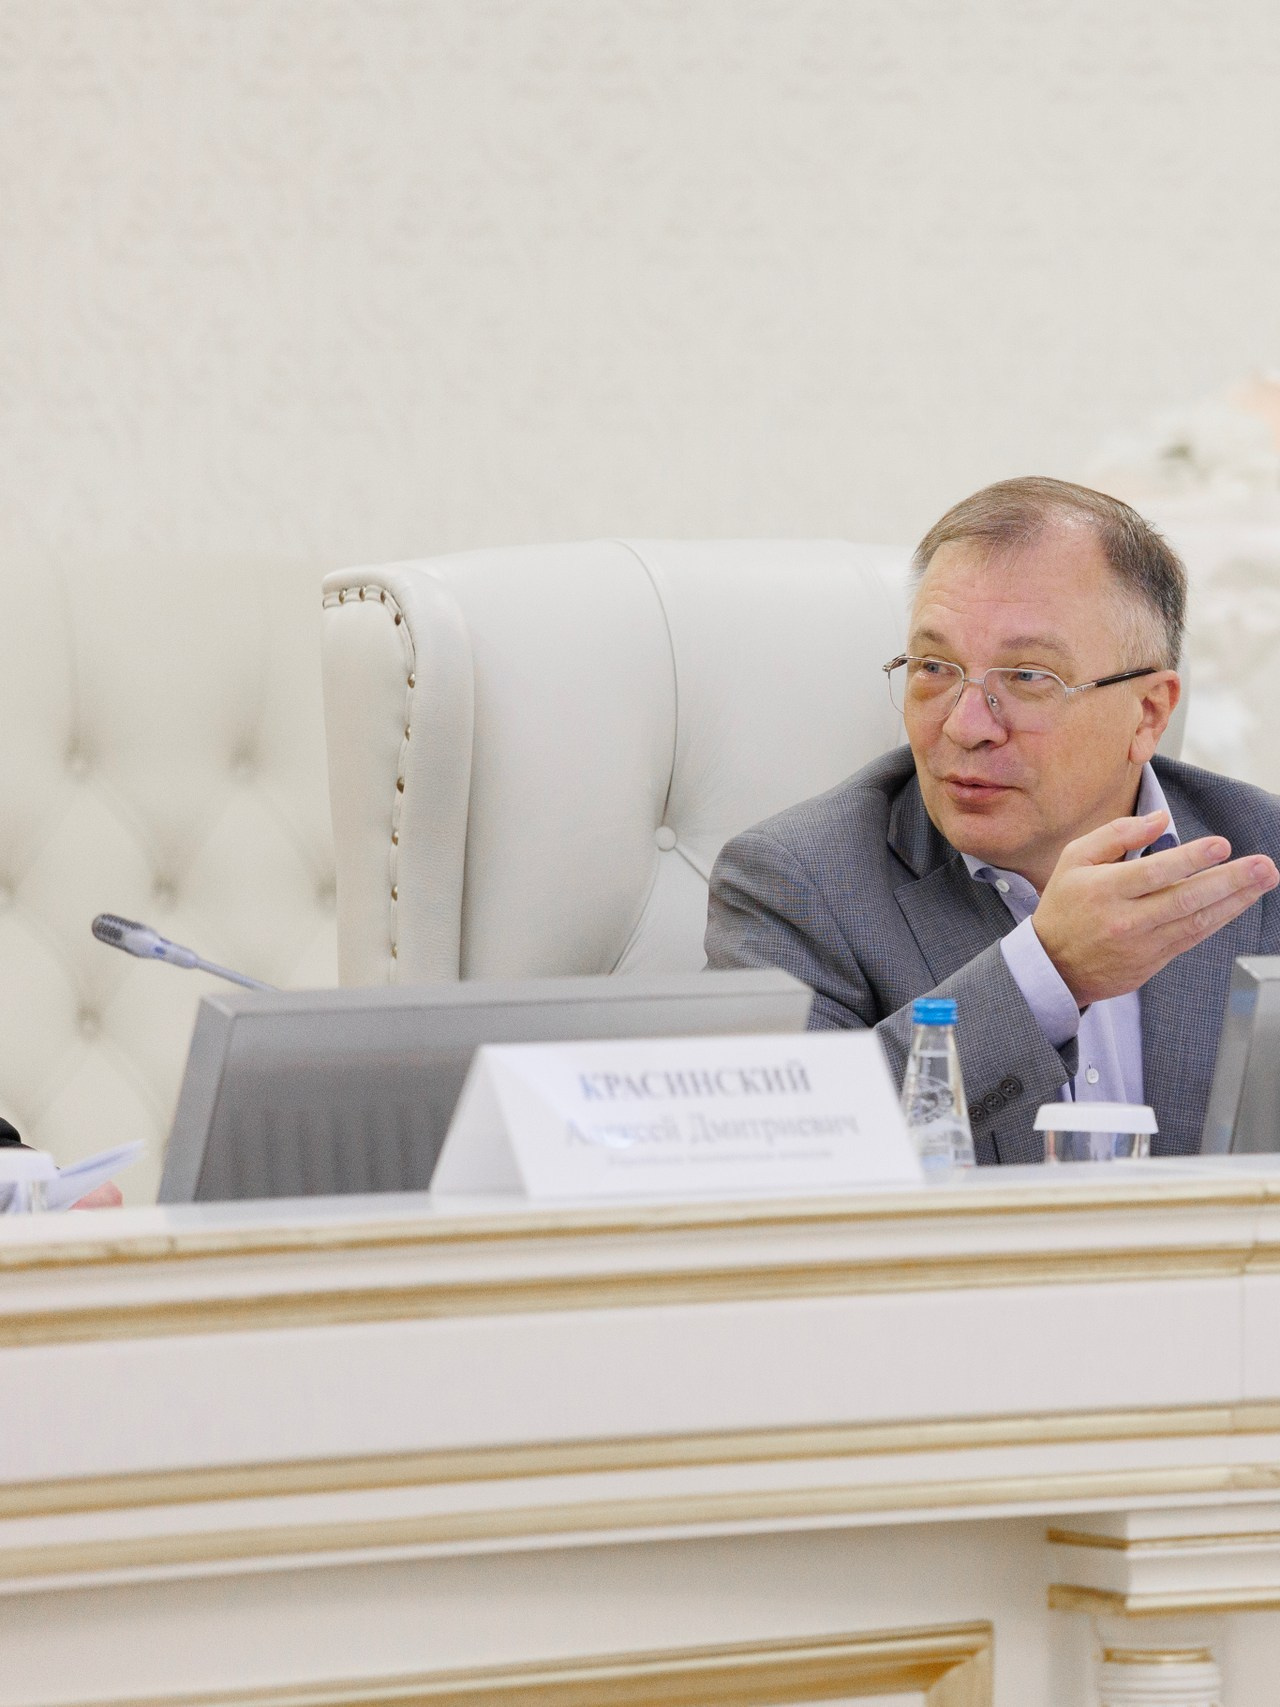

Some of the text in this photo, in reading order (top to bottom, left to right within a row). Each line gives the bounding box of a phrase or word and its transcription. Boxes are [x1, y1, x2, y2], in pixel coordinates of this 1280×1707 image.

[580, 1060, 812, 1101] КРАСИНСКИЙ
[566, 1111, 860, 1147] Аексей Дмитриевич
